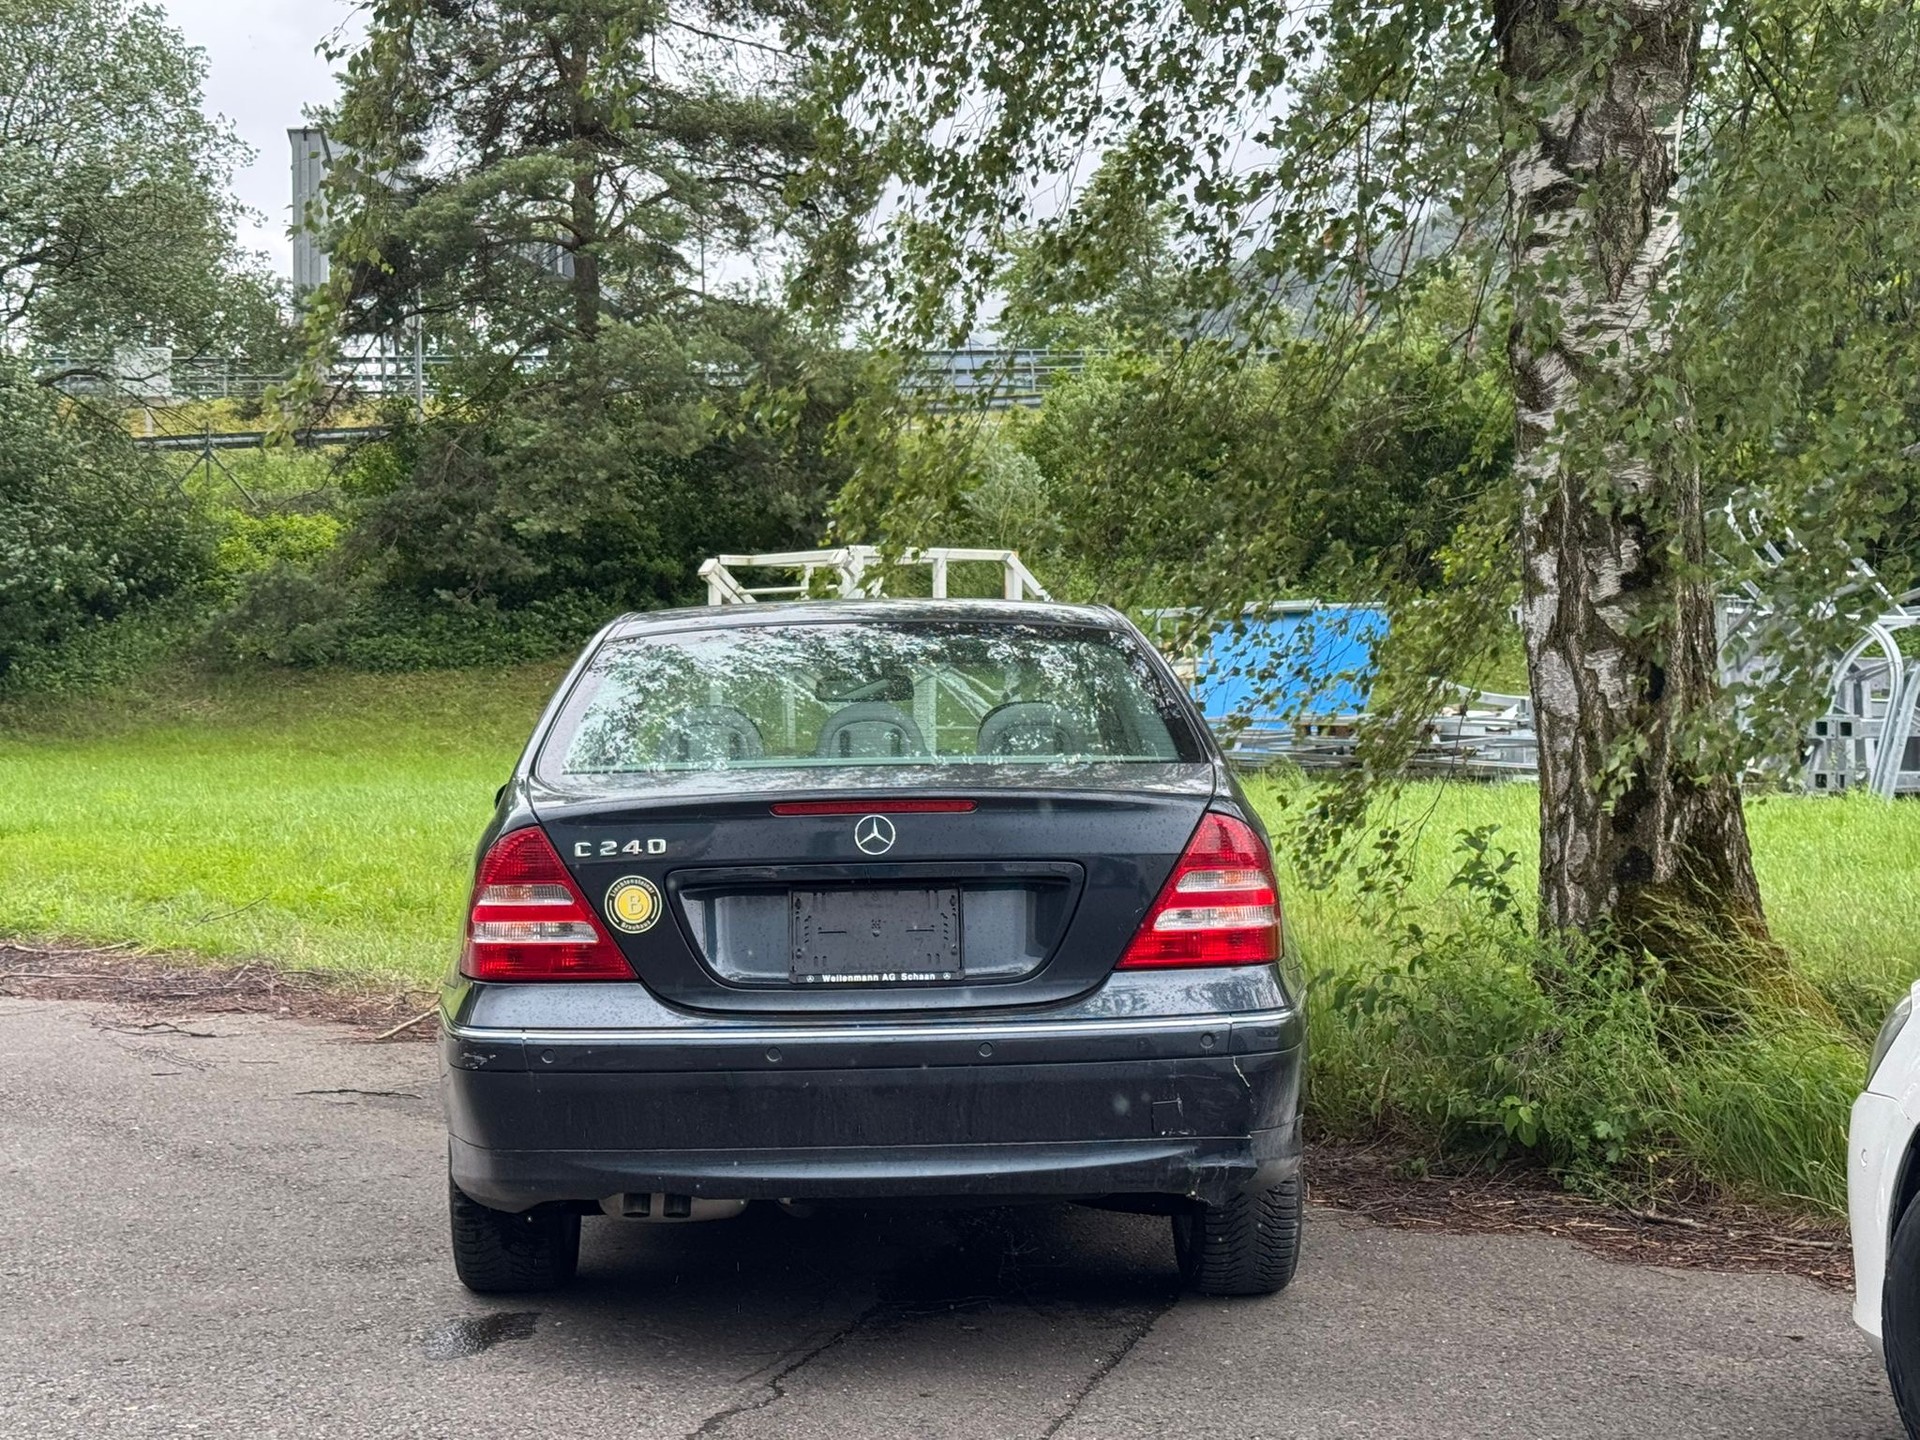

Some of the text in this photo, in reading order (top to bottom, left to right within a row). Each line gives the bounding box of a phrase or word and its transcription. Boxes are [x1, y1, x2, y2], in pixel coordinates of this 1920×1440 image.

[574, 839, 667, 857] C 240
[628, 895, 644, 916] B
[620, 919, 651, 931] Brauhaus
[882, 973, 896, 982] AG
[900, 972, 936, 982] Schaan
